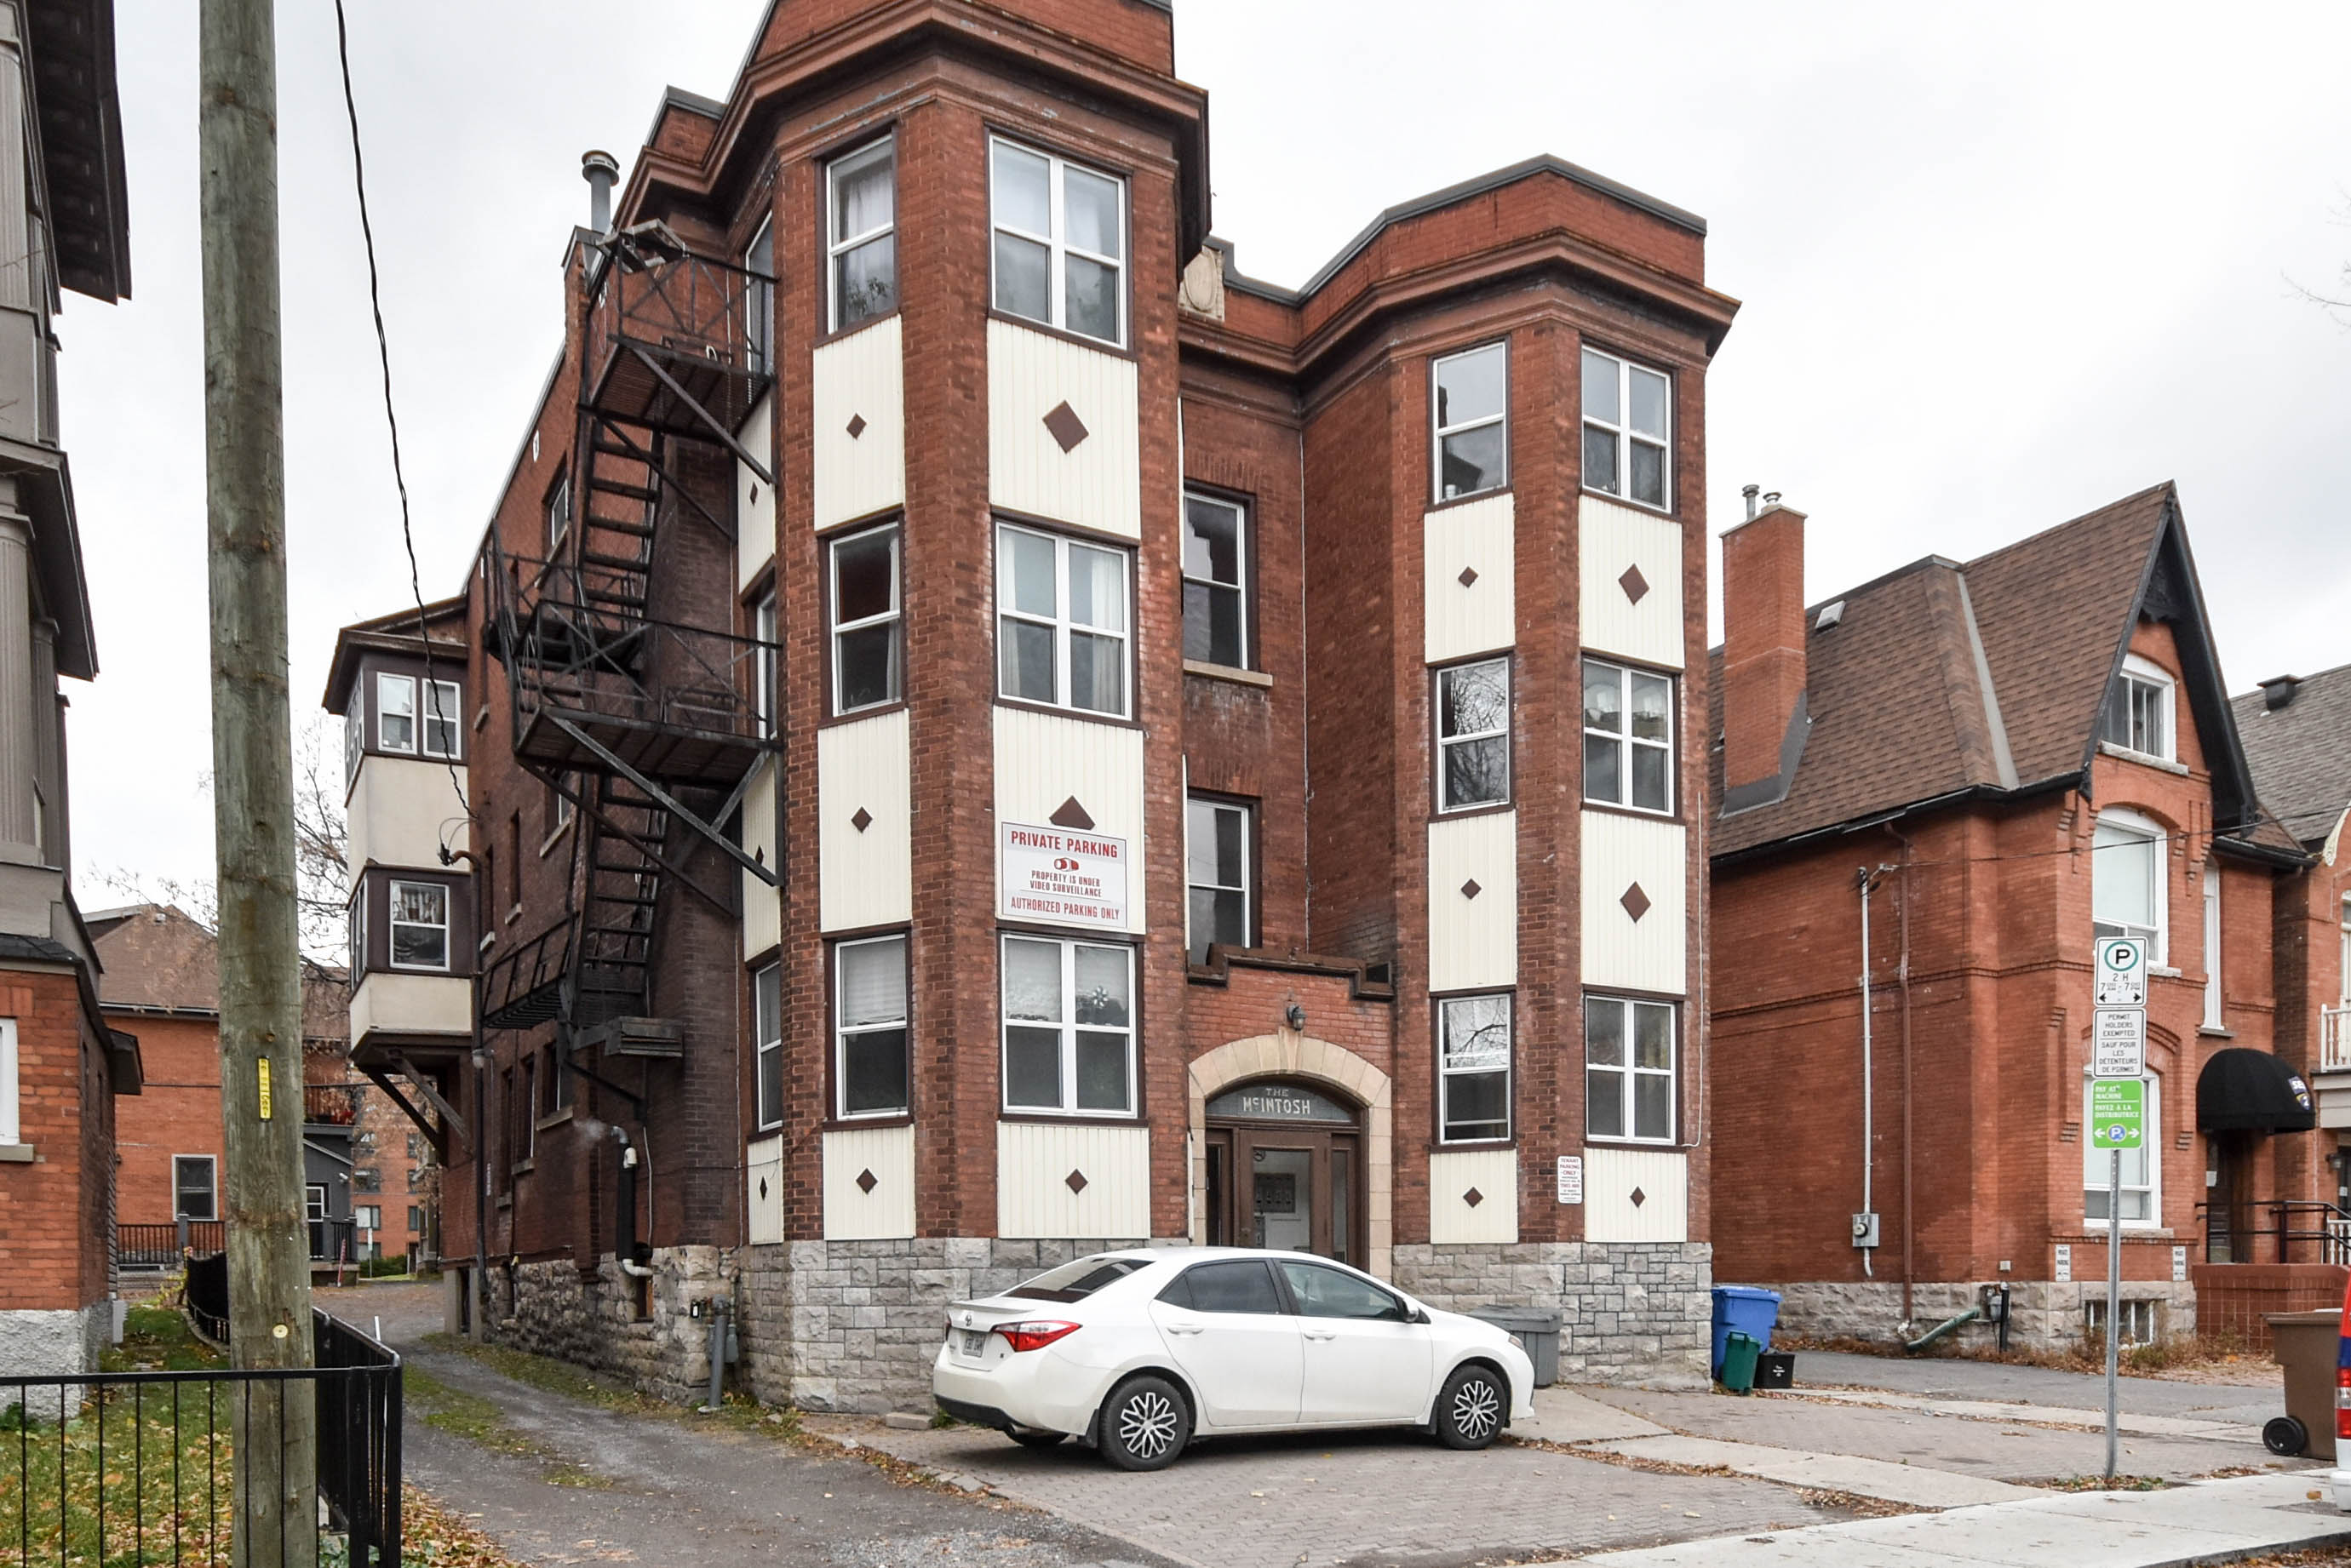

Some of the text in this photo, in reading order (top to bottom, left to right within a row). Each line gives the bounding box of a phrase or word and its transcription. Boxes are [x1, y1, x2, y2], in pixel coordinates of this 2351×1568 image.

[1011, 830, 1118, 858] PRIVATE PARKING
[1031, 870, 1100, 887] PROPERTY IS UNDER
[1029, 879, 1102, 897] VIDEO SURVEILLANCE
[1011, 896, 1120, 919] AUTHORIZED PARKING ONLY
[2115, 949, 2130, 964] P
[2113, 973, 2119, 981] 2
[2101, 982, 2106, 991] 7
[2125, 982, 2130, 991] 7
[1265, 1088, 1288, 1097] THE
[2111, 1128, 2121, 1137] P
